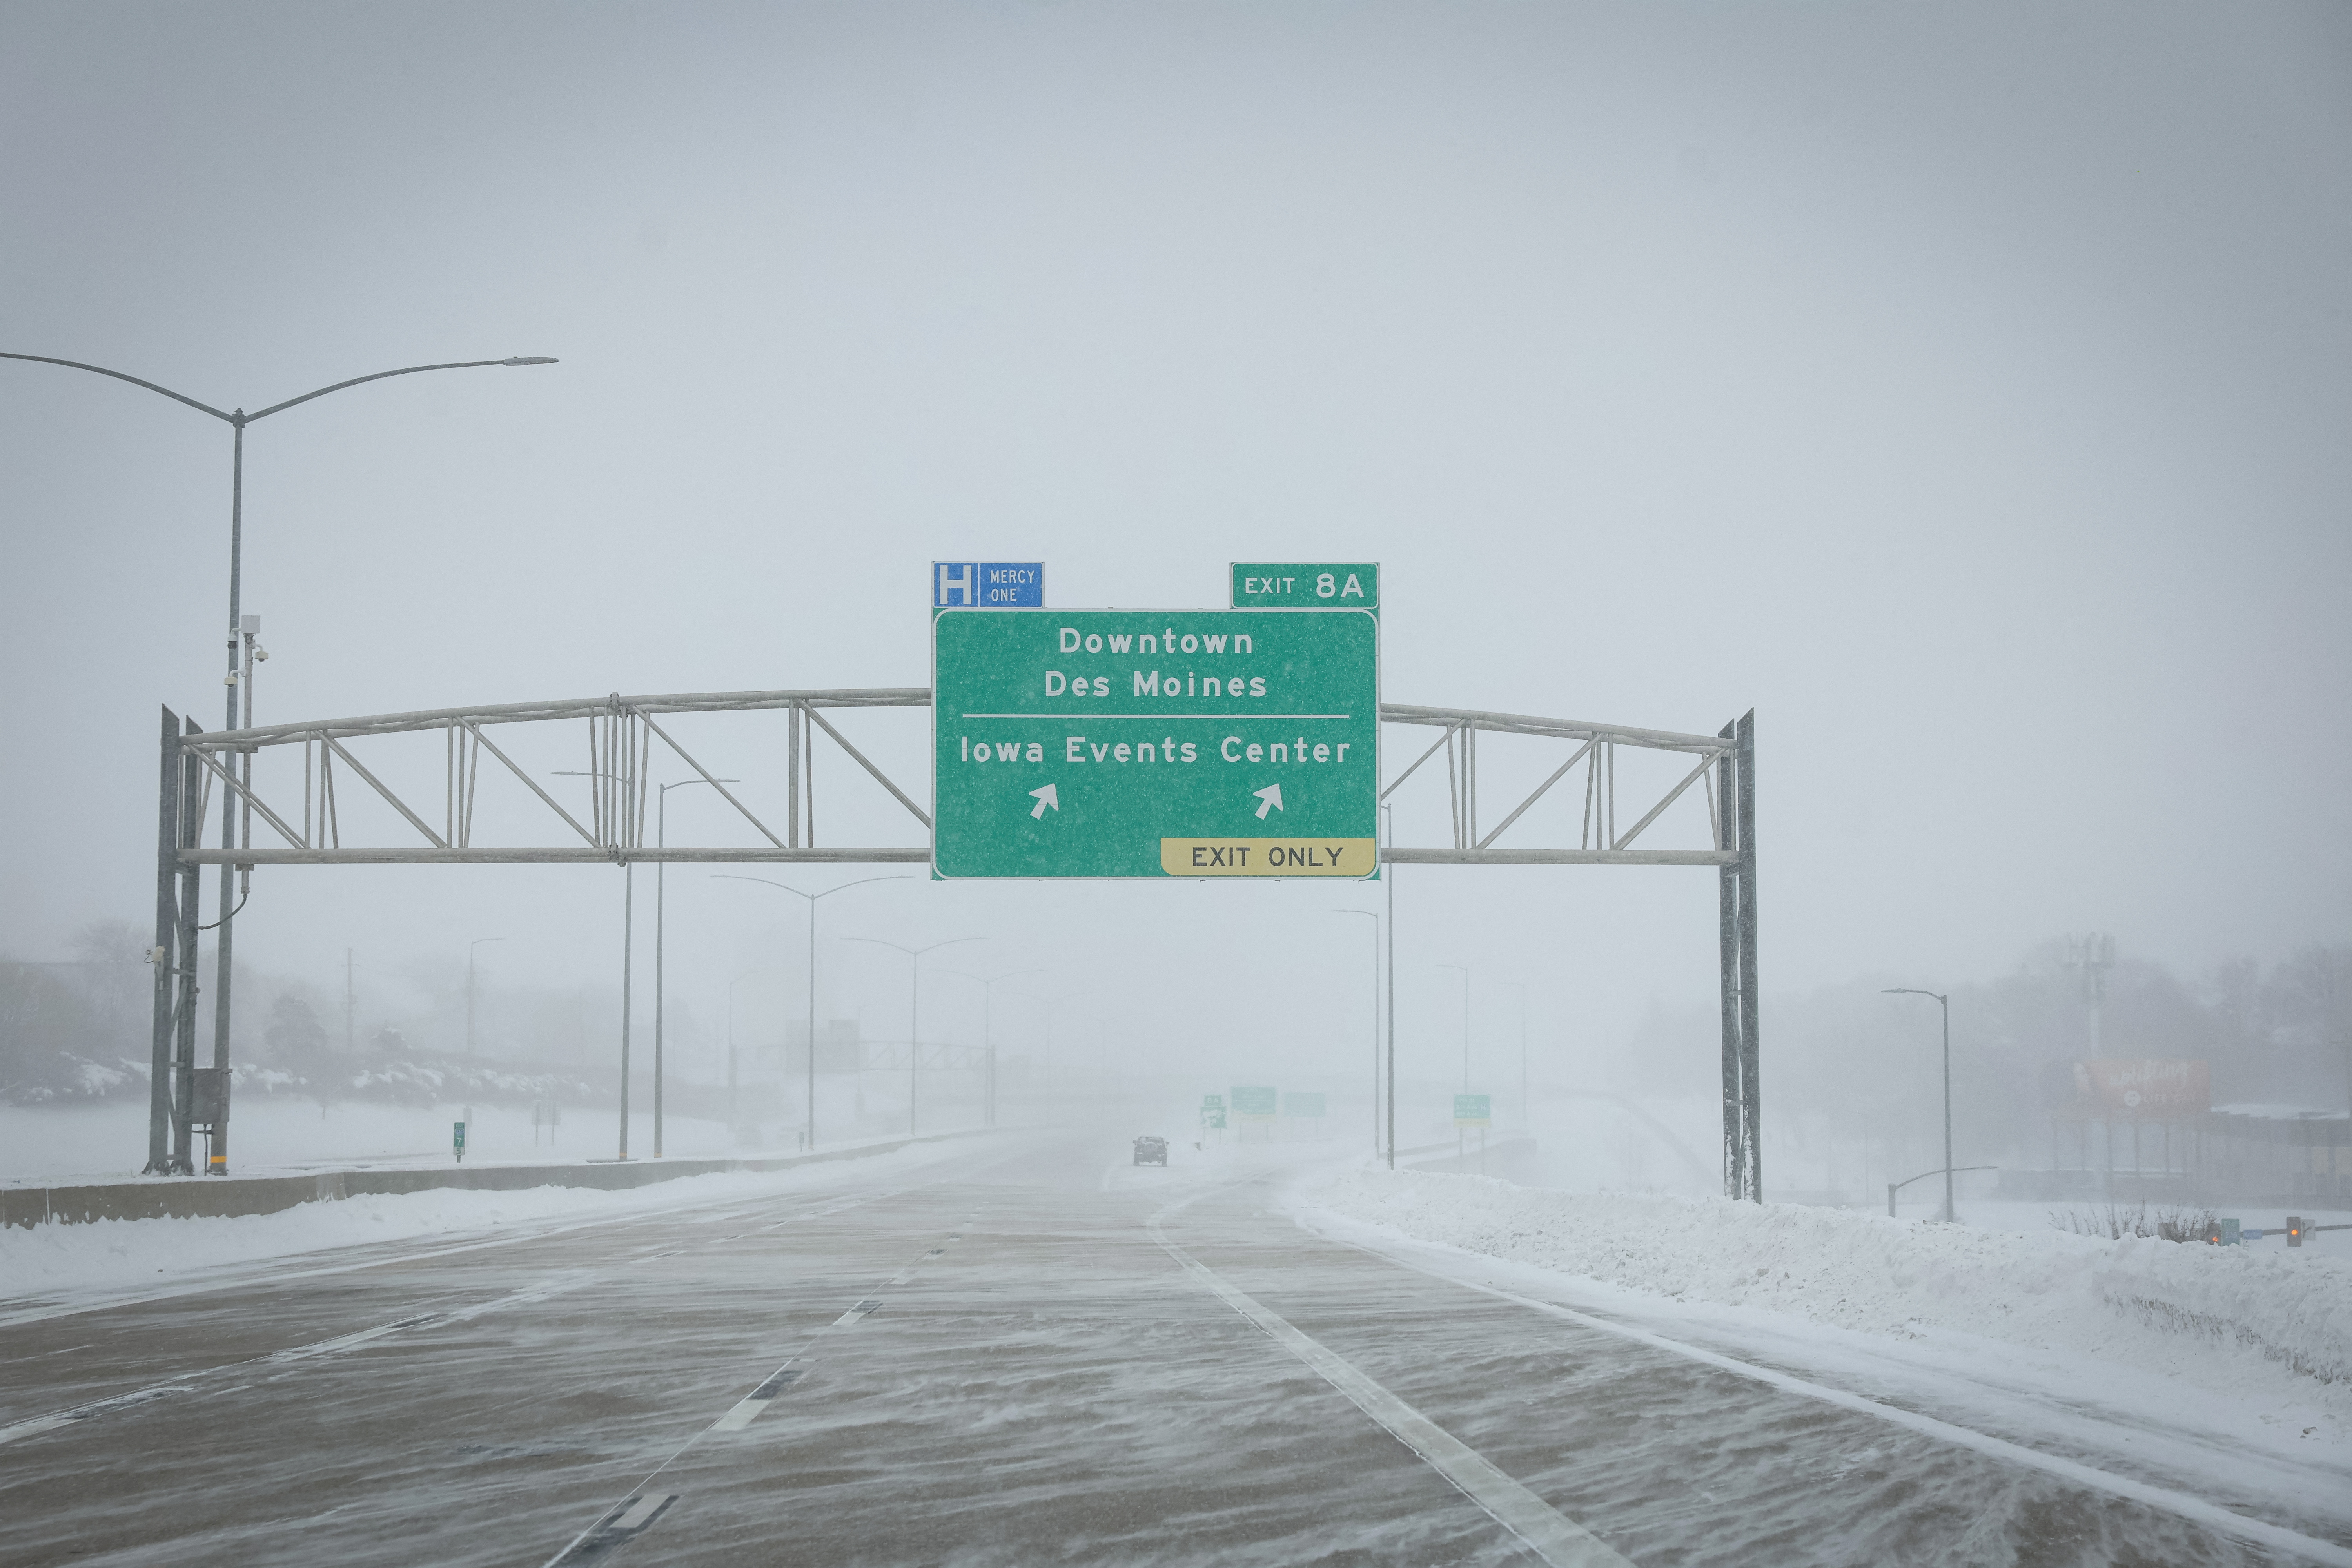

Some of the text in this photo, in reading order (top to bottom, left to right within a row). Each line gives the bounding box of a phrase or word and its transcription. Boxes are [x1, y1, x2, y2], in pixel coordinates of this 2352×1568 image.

[940, 565, 971, 604] H
[991, 570, 1034, 583] MERCY
[1245, 573, 1364, 598] EXIT 8A
[991, 589, 1016, 601] ONE
[1060, 628, 1252, 654] Downtown
[1046, 671, 1266, 697] Des Moines
[962, 736, 1350, 763] Iowa Events Center
[1193, 847, 1343, 867] EXIT ONLY
[2143, 1094, 2167, 1103] LIFE
